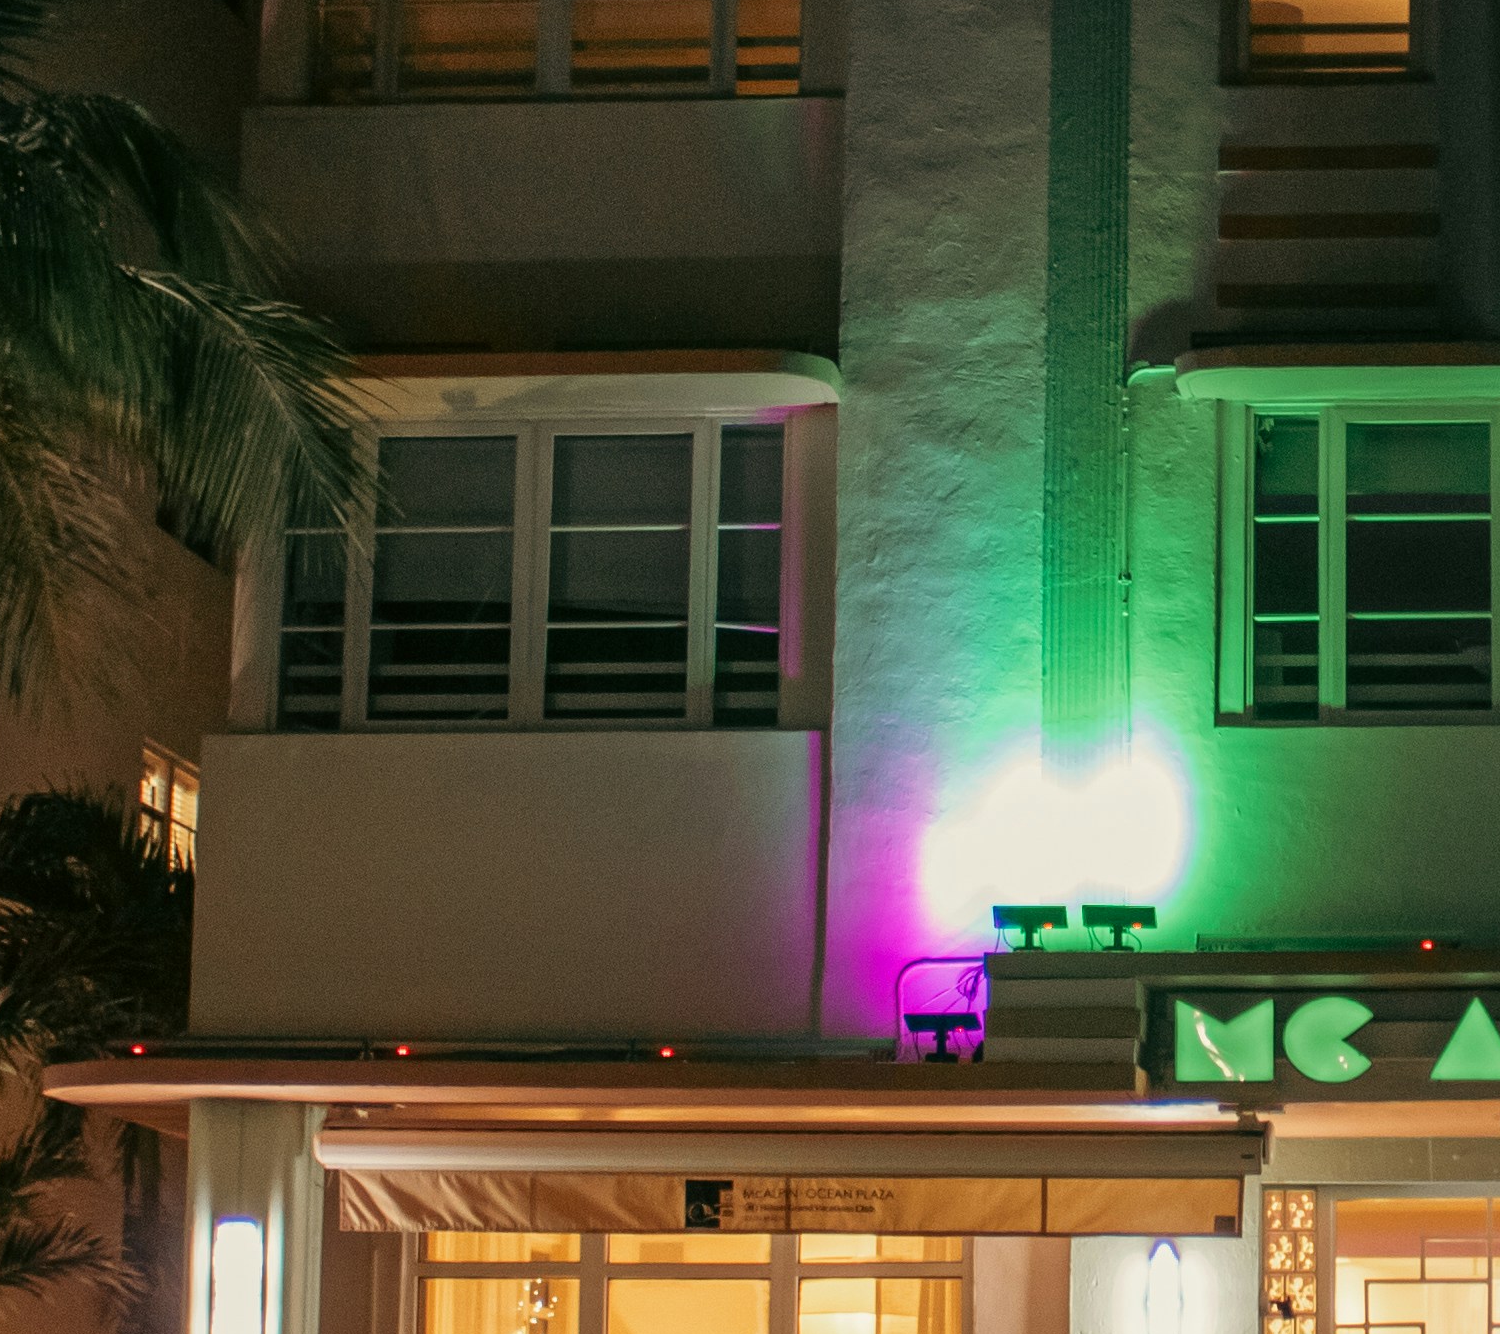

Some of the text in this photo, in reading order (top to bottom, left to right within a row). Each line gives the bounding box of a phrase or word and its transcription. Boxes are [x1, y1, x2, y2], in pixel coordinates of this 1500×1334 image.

[1175, 995, 1374, 1083] MC
[805, 1187, 853, 1199] OCEAN
[855, 1187, 895, 1200] PLAZA
